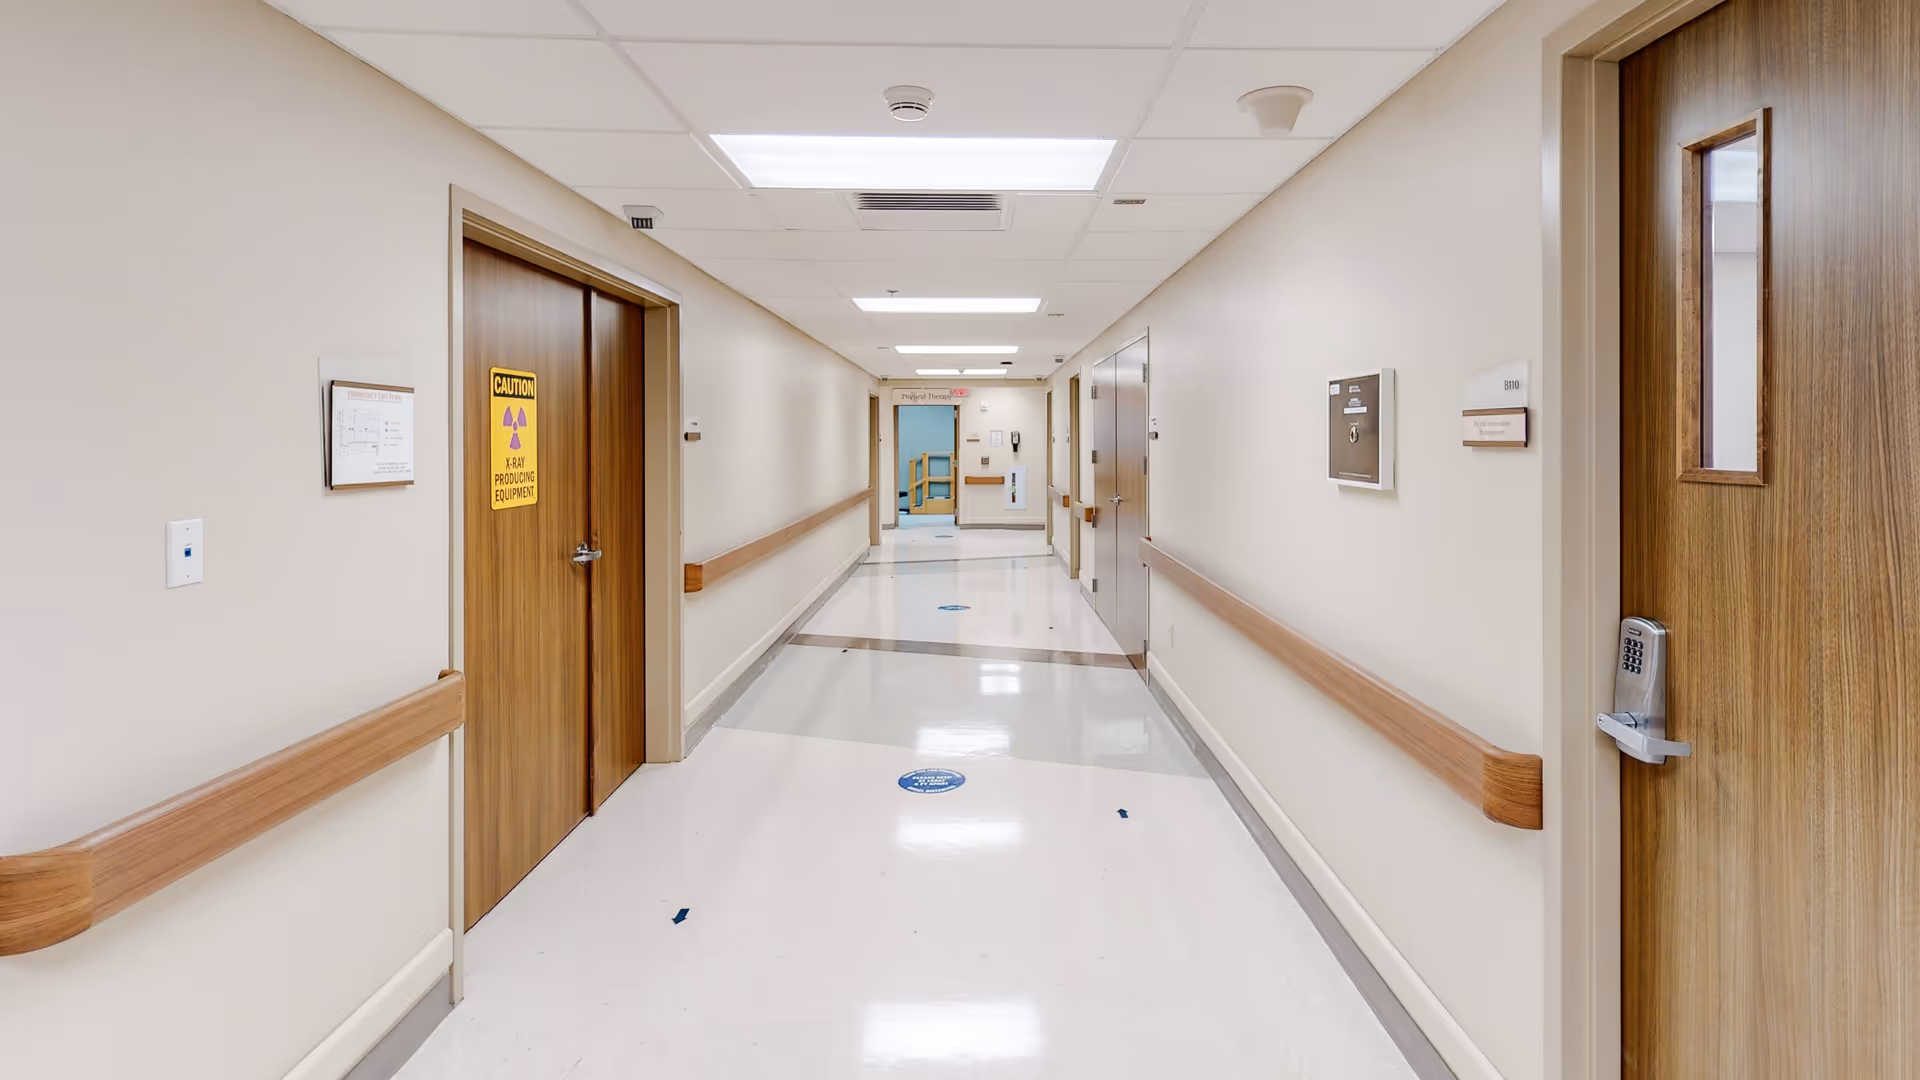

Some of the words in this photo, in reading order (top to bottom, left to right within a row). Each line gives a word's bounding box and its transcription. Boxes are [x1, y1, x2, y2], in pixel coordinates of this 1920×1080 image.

[494, 376, 534, 397] CAUTION
[1504, 380, 1519, 390] B110
[505, 456, 525, 469] X-RAY
[495, 471, 534, 486] PRODUCING
[495, 486, 534, 503] EQUIPMENT
